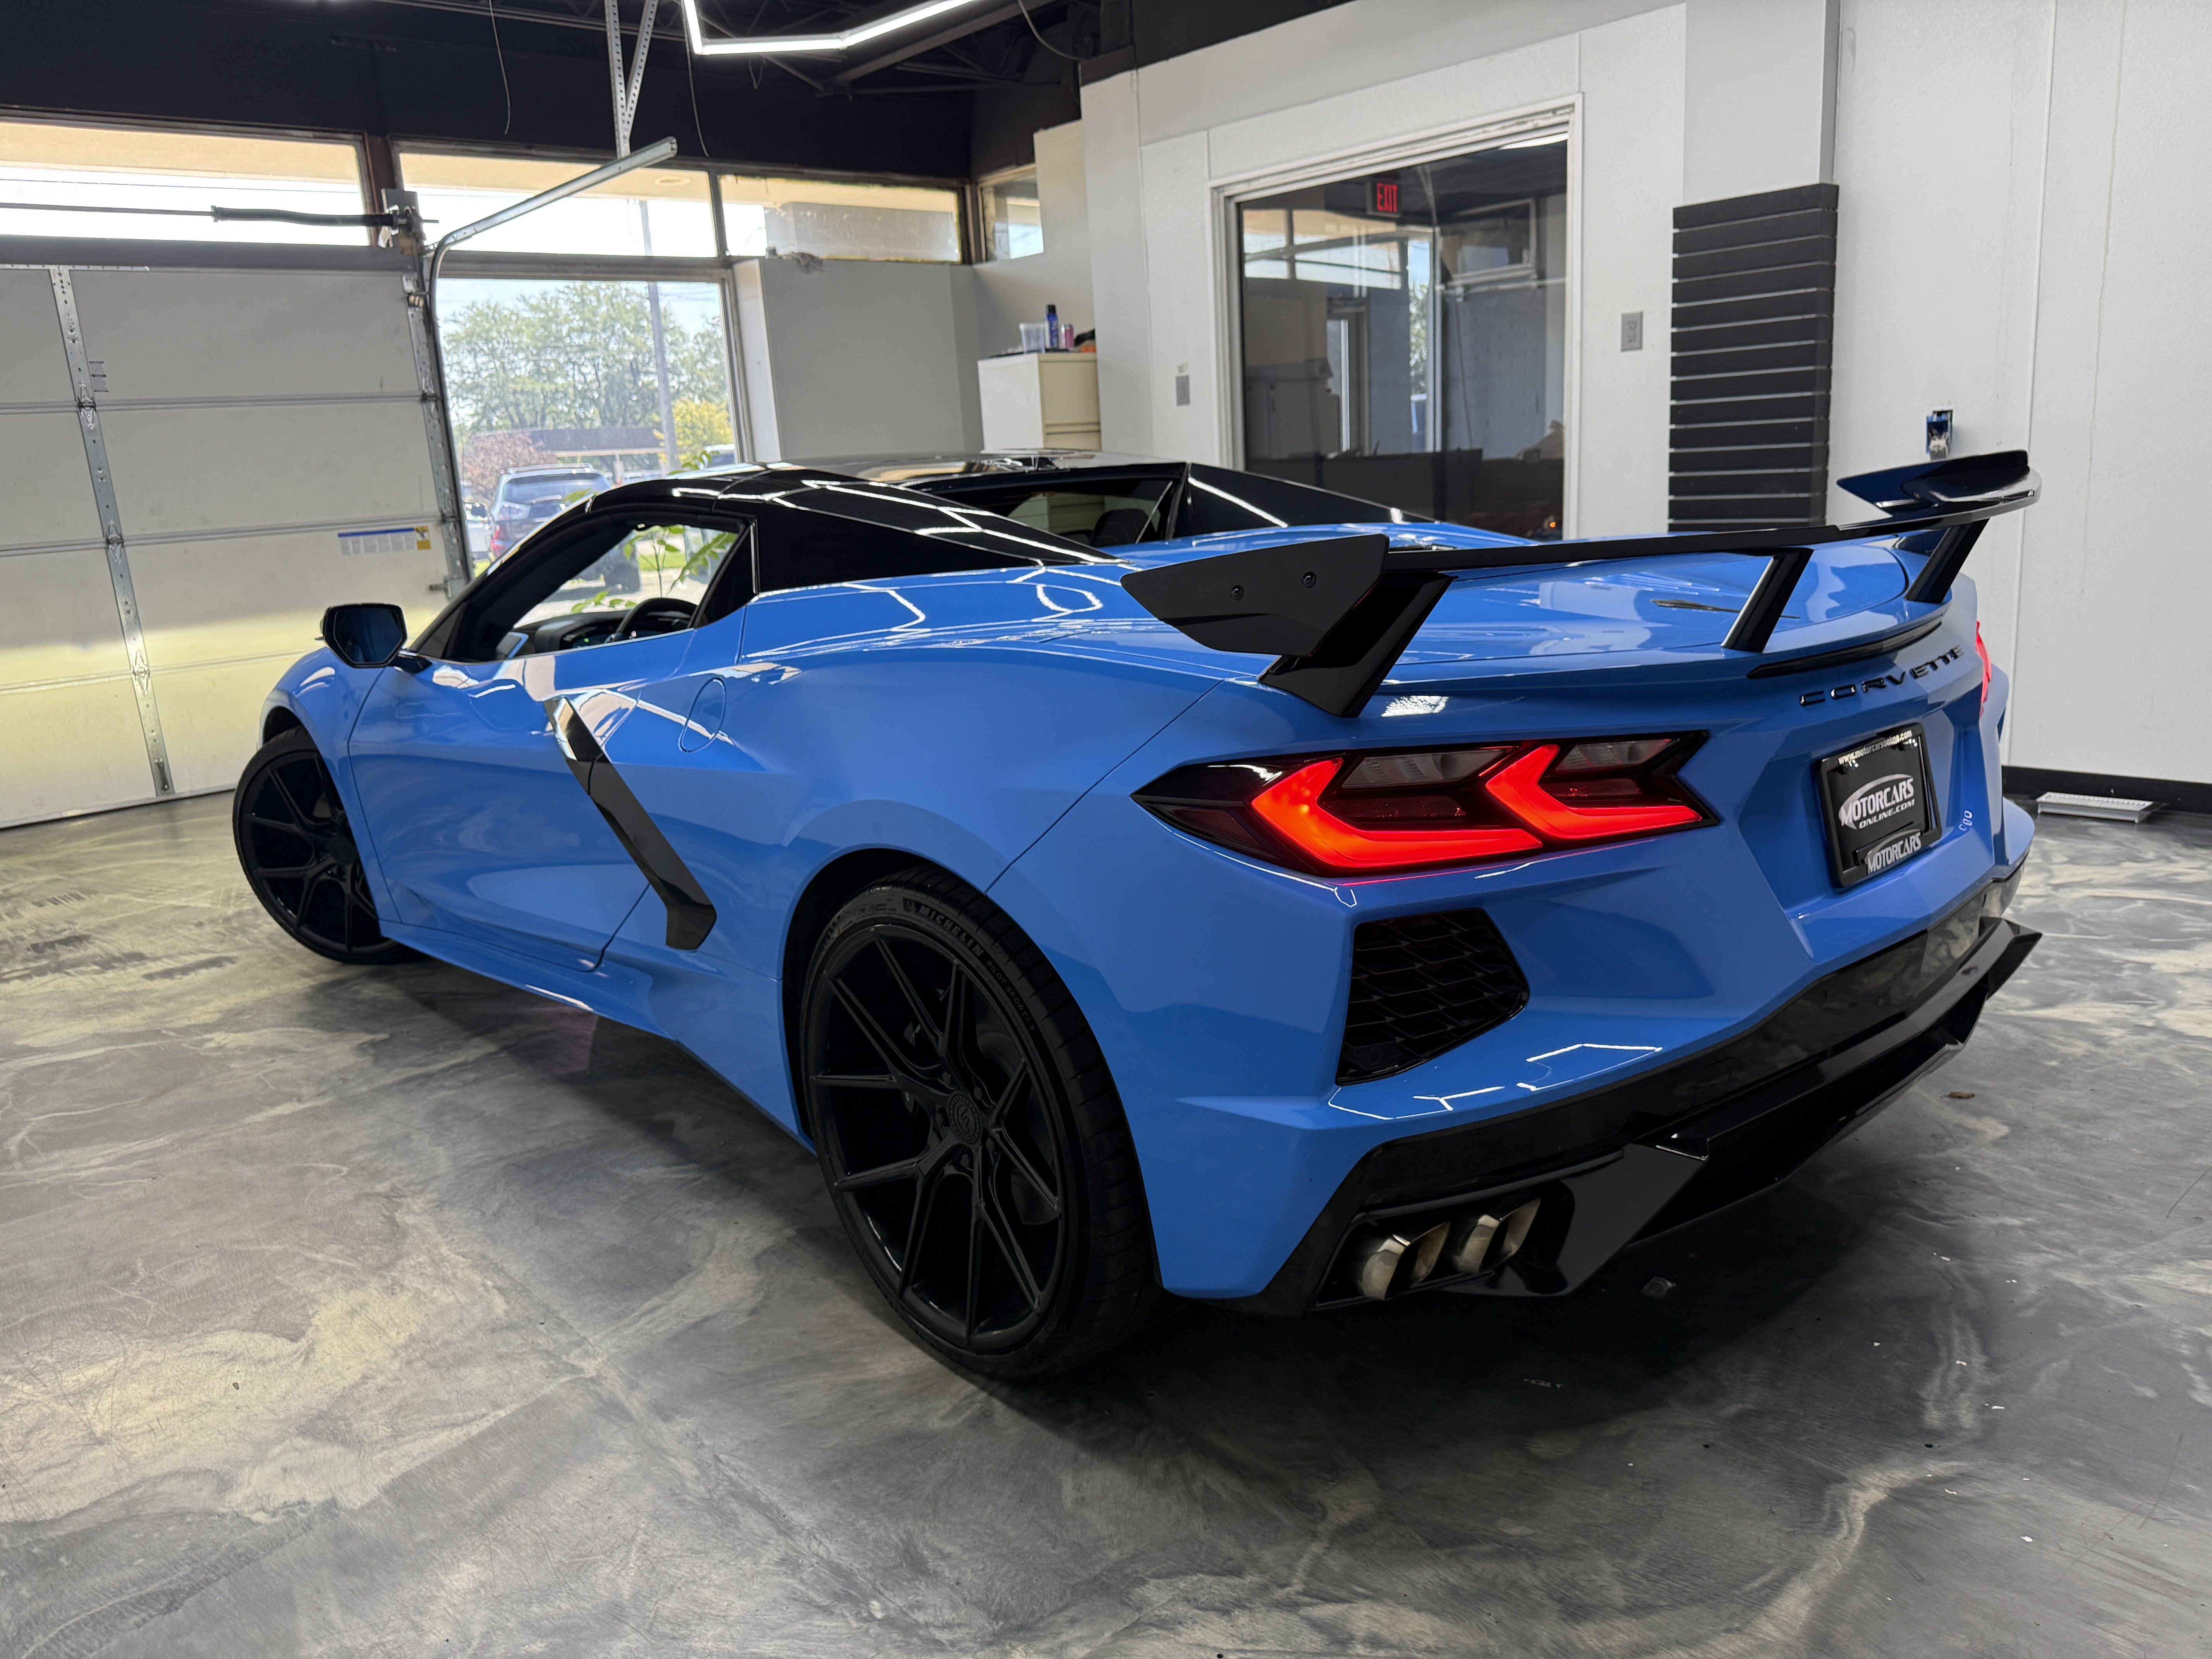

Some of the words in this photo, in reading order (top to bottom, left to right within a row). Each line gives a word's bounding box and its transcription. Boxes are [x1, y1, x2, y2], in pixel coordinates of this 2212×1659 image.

[1377, 183, 1398, 213] EXIT
[1800, 644, 1965, 706] CORVETTE
[1838, 730, 1912, 765] www.motorcarsonline.com
[1841, 777, 1914, 826] MOTORCARS
[1859, 799, 1915, 829] ONLINE.COM
[1868, 831, 1922, 874] MOTORCARS
[919, 905, 984, 957] MICHELIN
[986, 961, 1006, 984] PILOT
[1006, 986, 1028, 1017] SPORT
